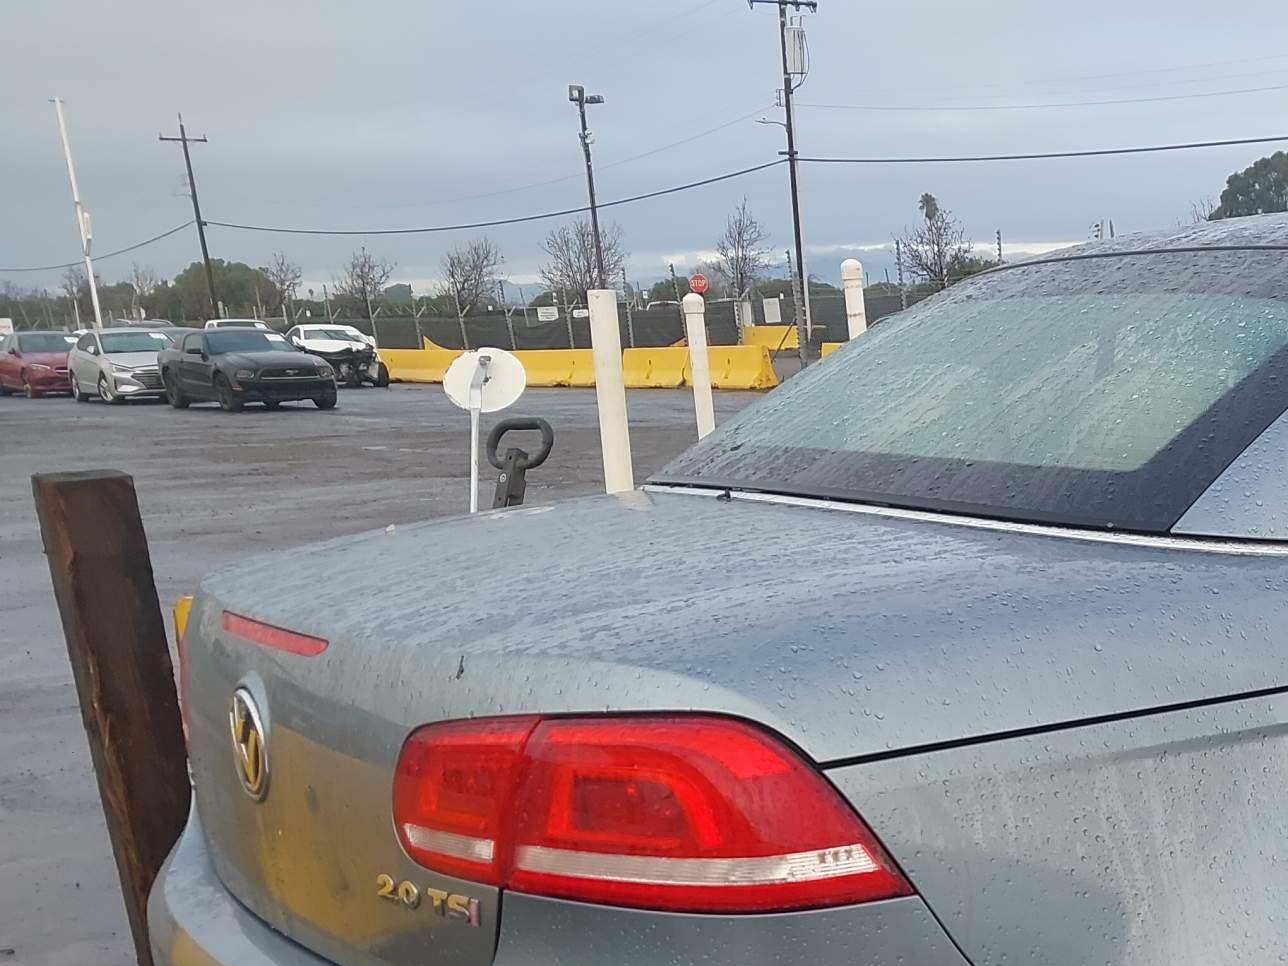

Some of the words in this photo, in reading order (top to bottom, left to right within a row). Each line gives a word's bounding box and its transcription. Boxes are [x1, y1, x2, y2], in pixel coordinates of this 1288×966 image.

[690, 279, 706, 288] STOP
[376, 873, 419, 909] 2.0
[427, 887, 480, 928] TSI
